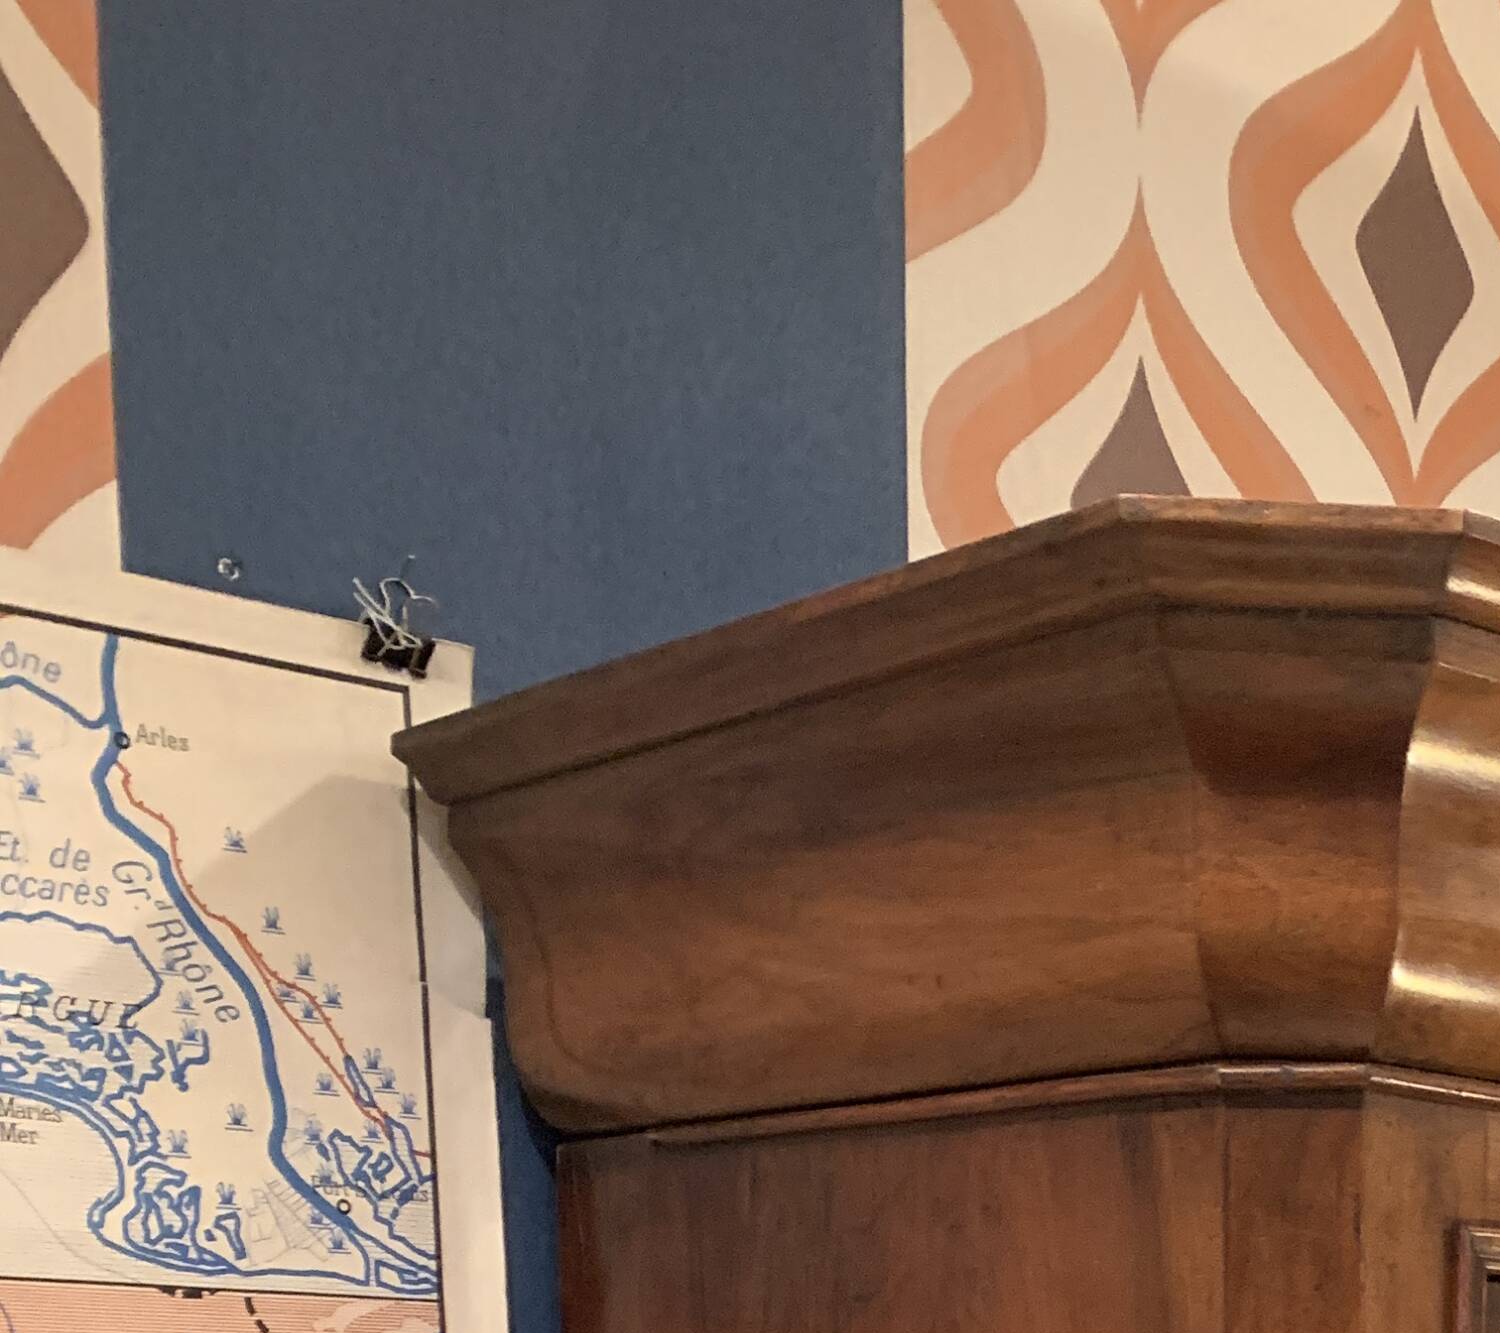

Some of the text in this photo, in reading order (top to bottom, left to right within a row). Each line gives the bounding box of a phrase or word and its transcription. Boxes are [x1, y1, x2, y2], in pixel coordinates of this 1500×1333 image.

[135, 724, 190, 752] Arles
[49, 838, 90, 872] de
[146, 919, 240, 1023] Rhône
